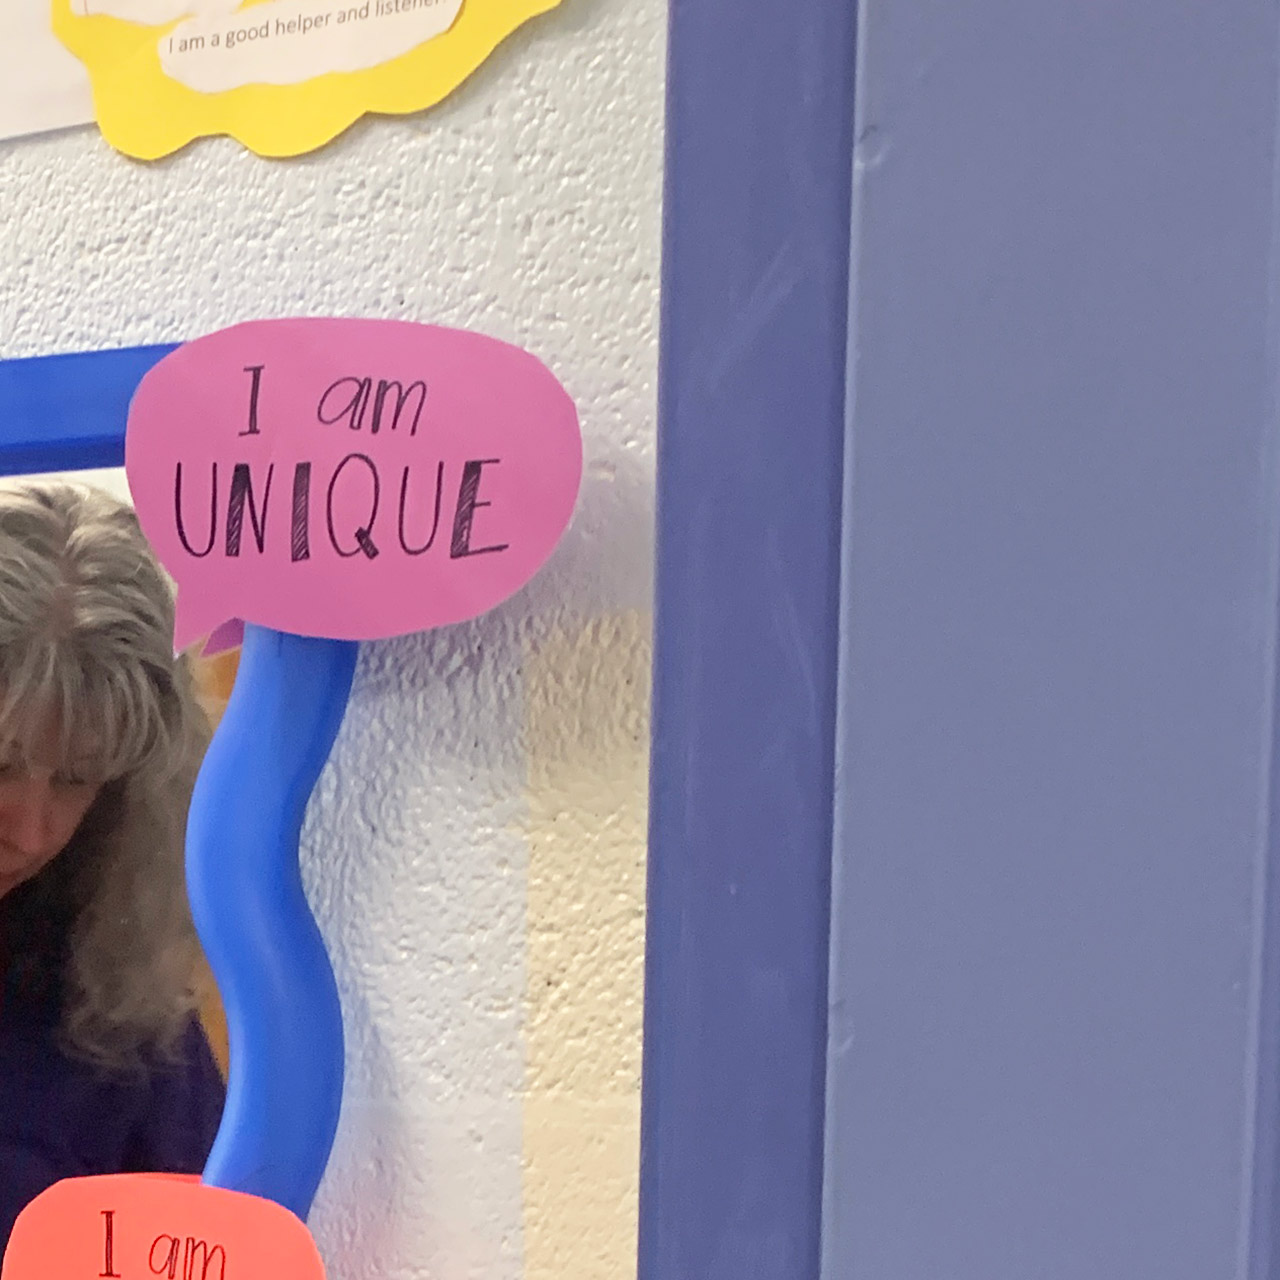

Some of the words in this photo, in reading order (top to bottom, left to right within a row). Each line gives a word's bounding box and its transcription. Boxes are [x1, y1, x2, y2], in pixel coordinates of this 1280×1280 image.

[178, 35, 205, 52] am
[210, 32, 221, 47] a
[225, 20, 270, 48] good
[275, 11, 332, 34] helper
[336, 1, 370, 24] and
[238, 364, 265, 437] I
[316, 376, 427, 437] am
[174, 453, 510, 562] UNIQUE
[98, 1209, 122, 1279] I
